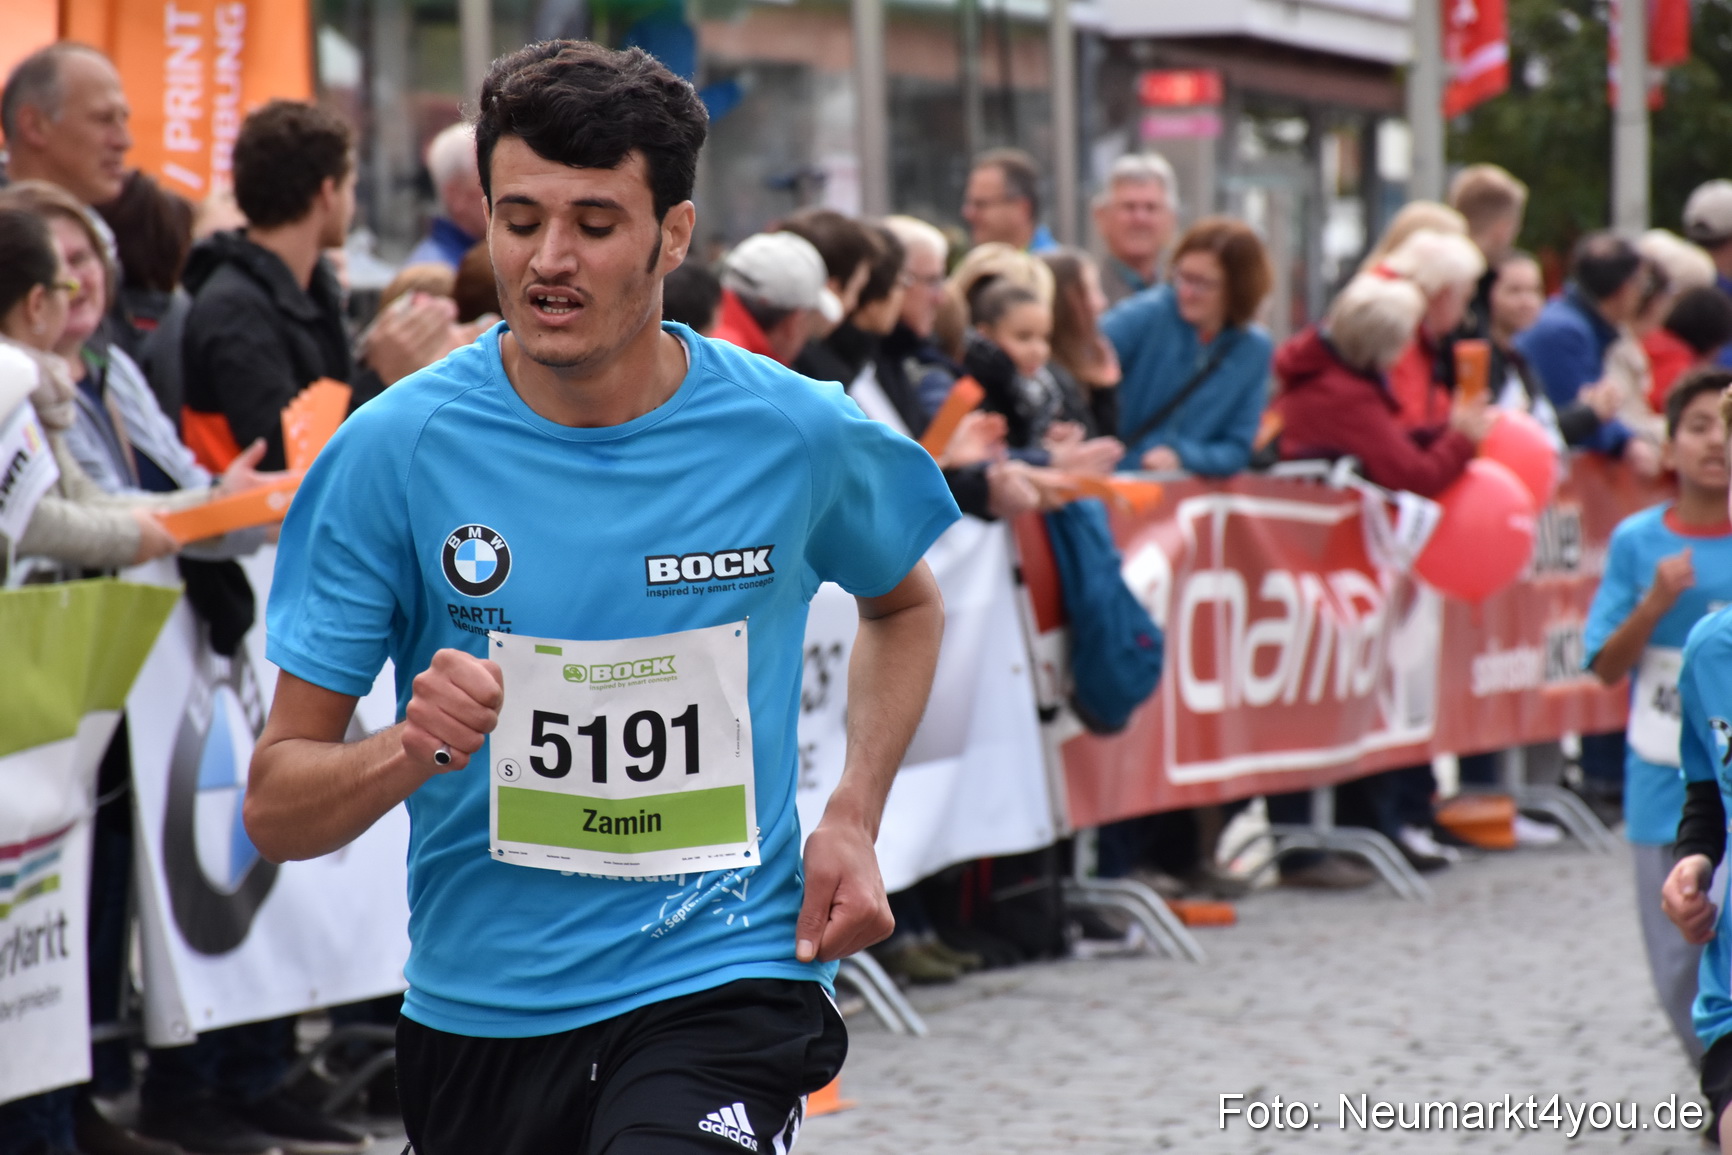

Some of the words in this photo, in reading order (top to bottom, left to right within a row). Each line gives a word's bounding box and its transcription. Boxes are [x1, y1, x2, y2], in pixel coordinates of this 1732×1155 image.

[164, 1, 204, 152] PRINT
[447, 526, 505, 551] BMW
[646, 546, 774, 585] BOCK
[646, 585, 689, 598] inspired
[692, 585, 704, 596] by
[707, 582, 737, 593] smart
[738, 577, 775, 590] concepts
[447, 603, 512, 625] PARTL
[589, 655, 676, 683] BOCK
[589, 683, 617, 691] inspired
[627, 679, 647, 687] smart
[648, 675, 678, 684] concepts
[529, 704, 700, 784] 5191
[504, 764, 514, 777] S
[582, 808, 662, 836] Zamin
[698, 1120, 758, 1152] adidas
